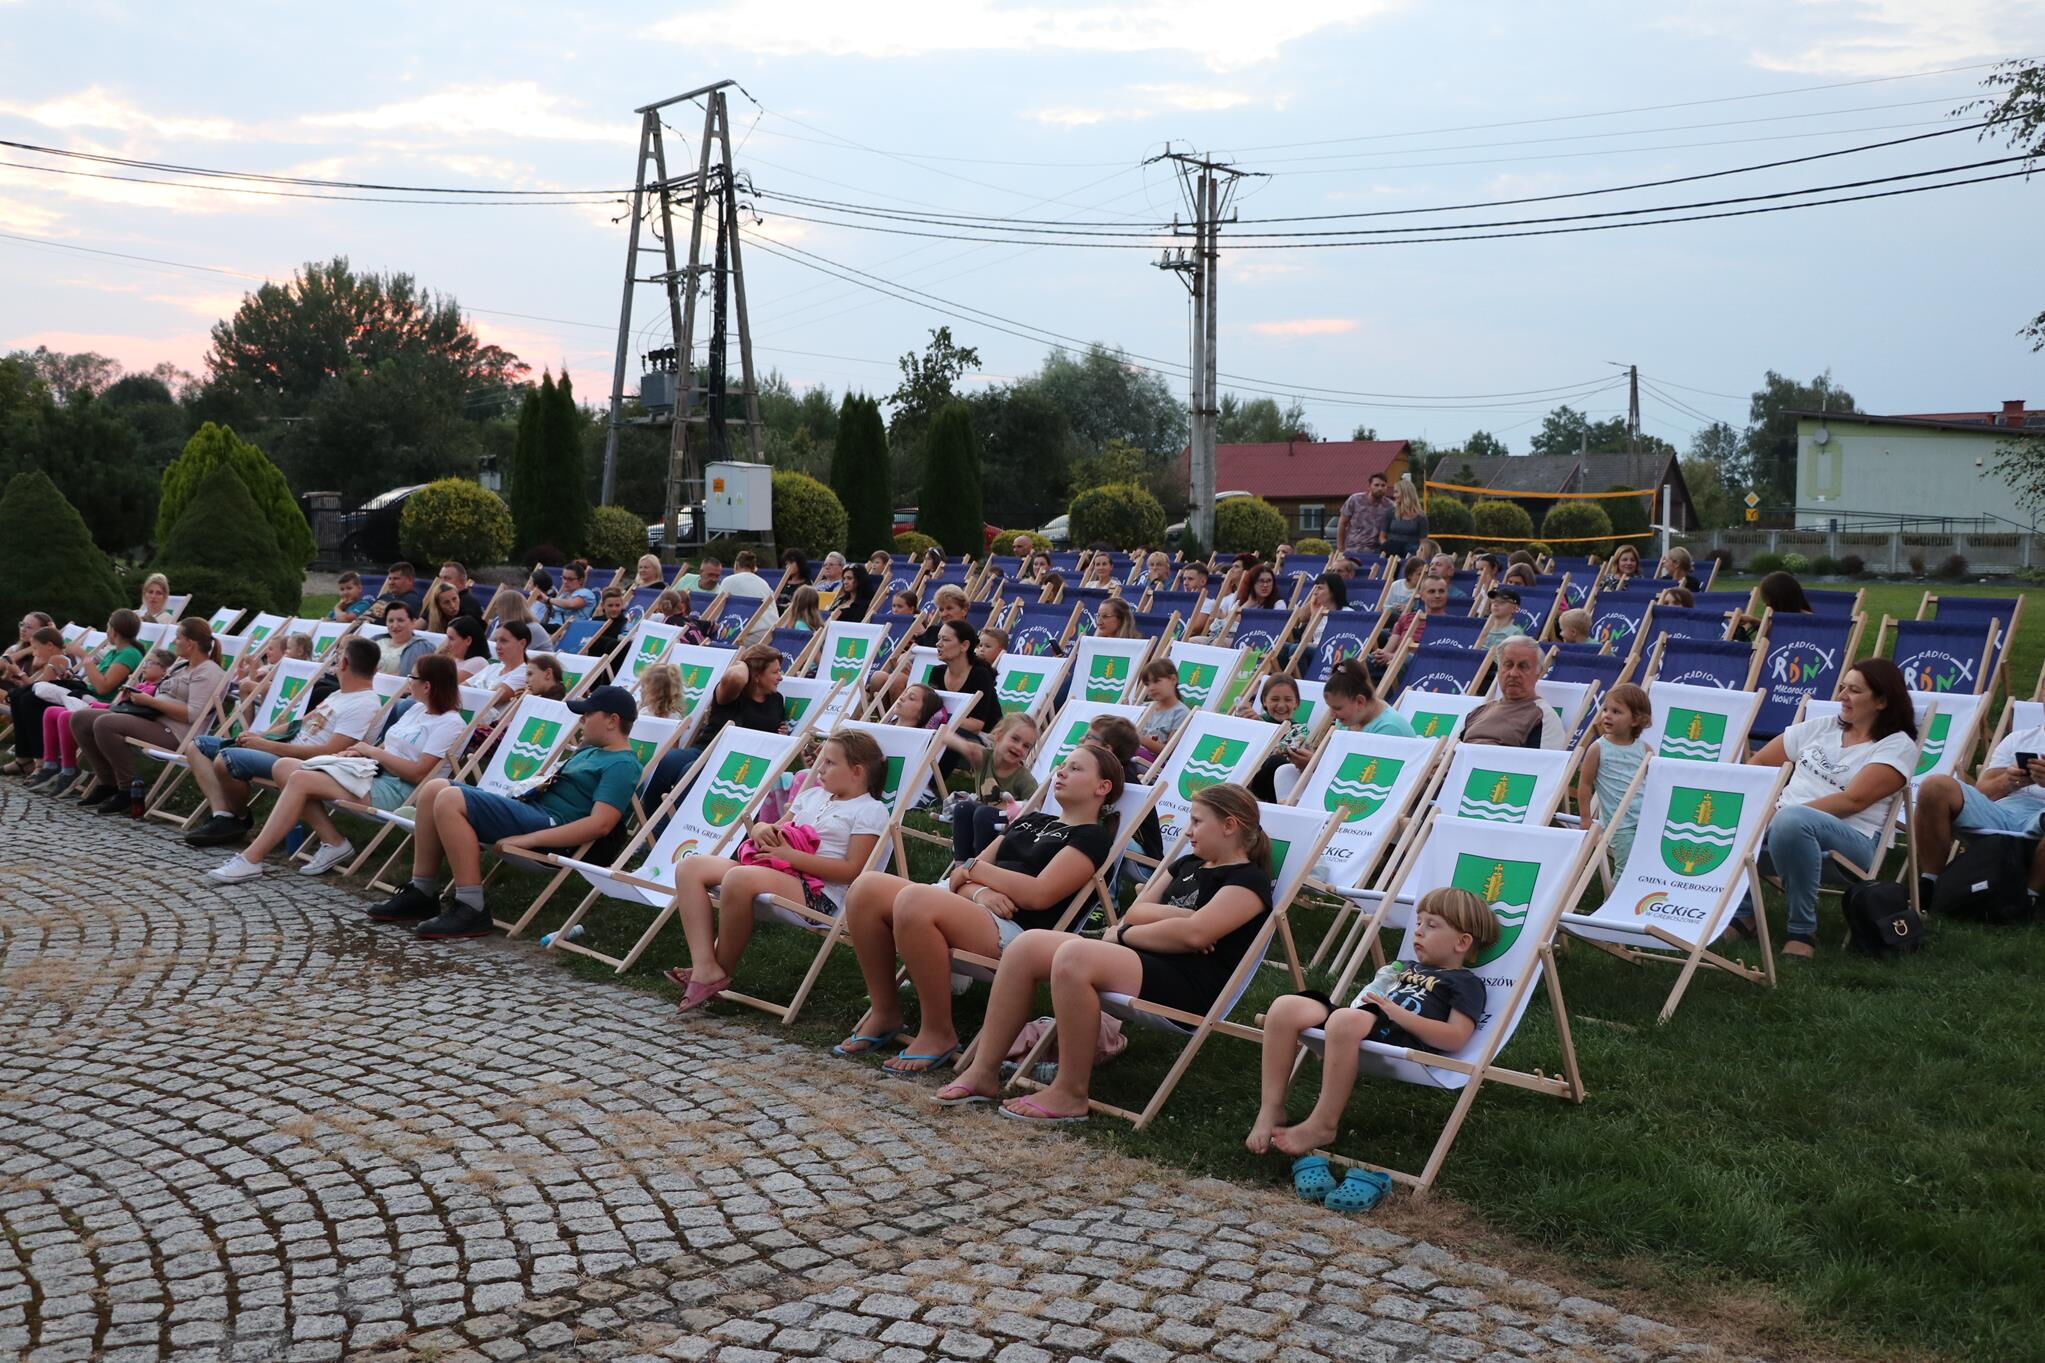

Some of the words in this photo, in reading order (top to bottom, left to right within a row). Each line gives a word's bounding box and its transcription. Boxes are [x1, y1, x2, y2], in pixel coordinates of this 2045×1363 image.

[1436, 637, 1459, 647] RADIO
[1788, 641, 1816, 651] RADIO
[1918, 650, 1951, 660] RADIO
[1428, 672, 1454, 682] RADIO
[1683, 670, 1714, 681] RADIO
[1638, 875, 1667, 886] GMINA
[1649, 902, 1707, 920] GCKiCz
